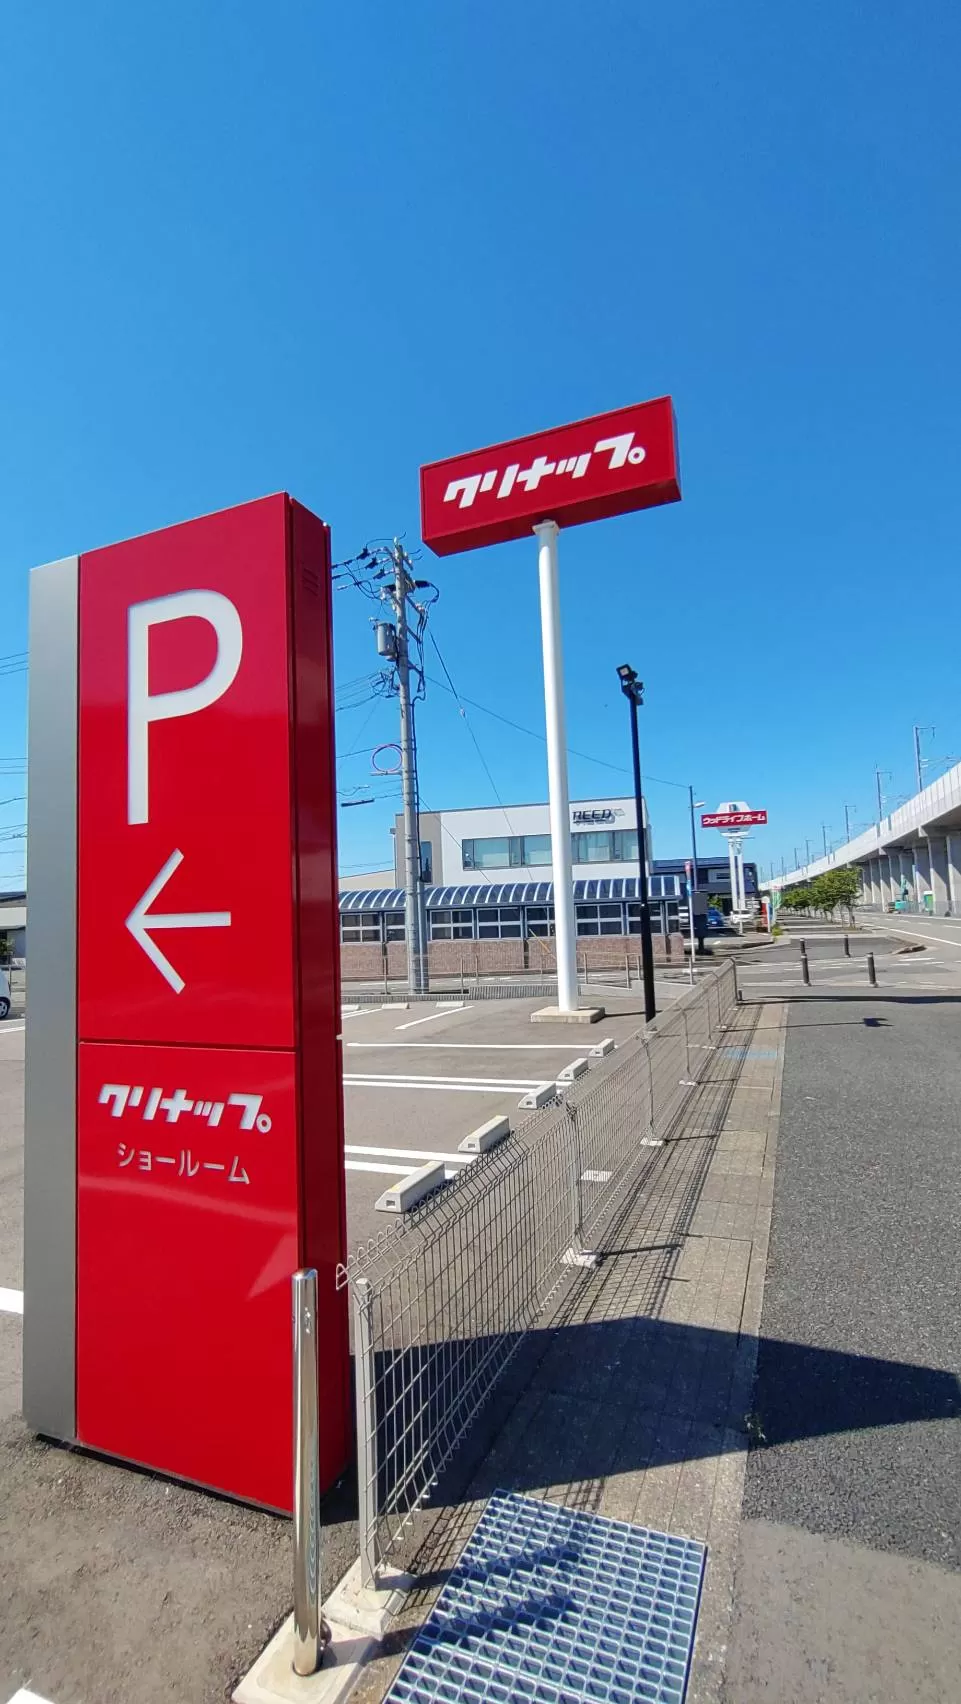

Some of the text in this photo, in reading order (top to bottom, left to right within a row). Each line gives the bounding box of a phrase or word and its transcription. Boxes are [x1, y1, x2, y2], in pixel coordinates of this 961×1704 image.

[443, 432, 646, 509] クリナップ
[128, 590, 243, 825] P
[572, 809, 611, 821] REED
[99, 1084, 272, 1133] クリナップ
[117, 1142, 251, 1185] ショールーム
